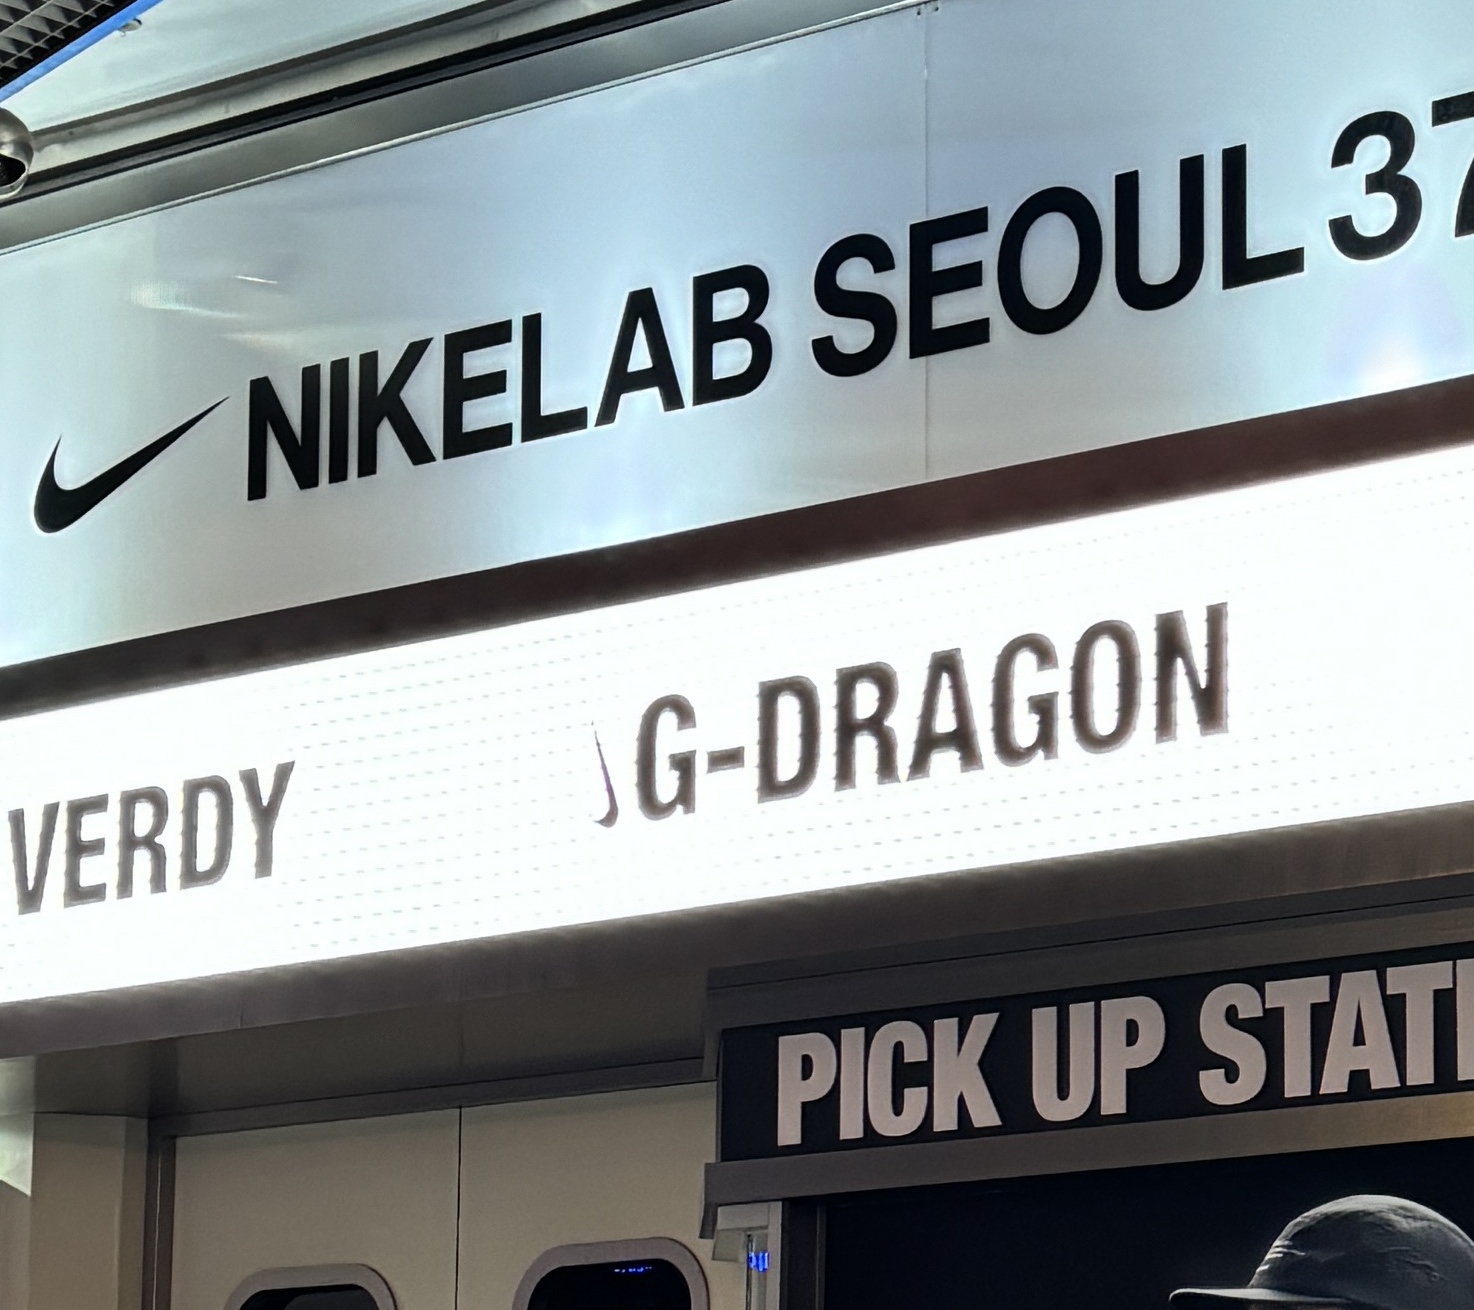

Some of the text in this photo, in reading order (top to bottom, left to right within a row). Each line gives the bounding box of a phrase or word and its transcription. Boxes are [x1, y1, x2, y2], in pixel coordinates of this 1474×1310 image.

[247, 265, 773, 501] NIKELAB
[811, 144, 1304, 378] SEOUL
[635, 602, 1228, 817] G-DRAGON
[8, 761, 295, 915] VERDY
[777, 1012, 1002, 1147] PICK
[1031, 996, 1166, 1122] UP
